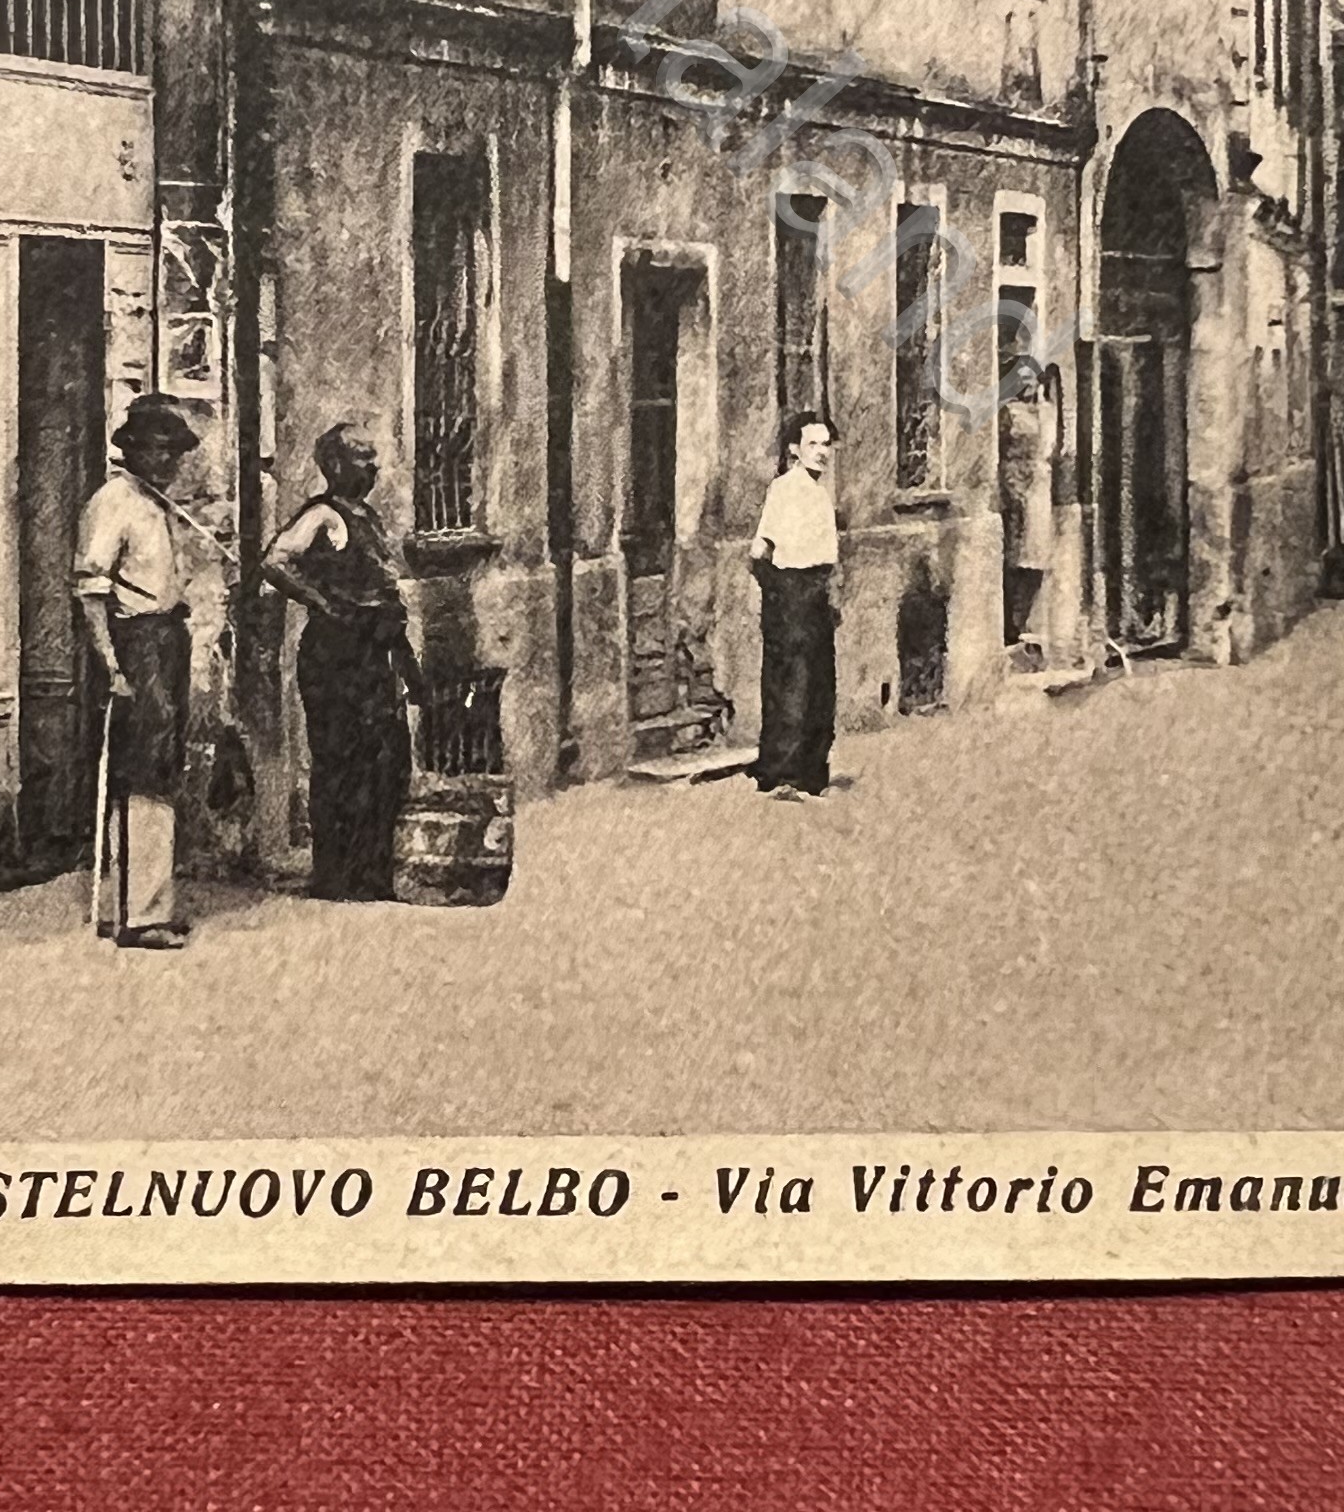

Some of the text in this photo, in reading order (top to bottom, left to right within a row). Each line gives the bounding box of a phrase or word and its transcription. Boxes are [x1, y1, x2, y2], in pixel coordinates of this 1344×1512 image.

[404, 1166, 631, 1217] BELBO
[715, 1165, 814, 1215] Via
[851, 1164, 1093, 1214] Vittorio
